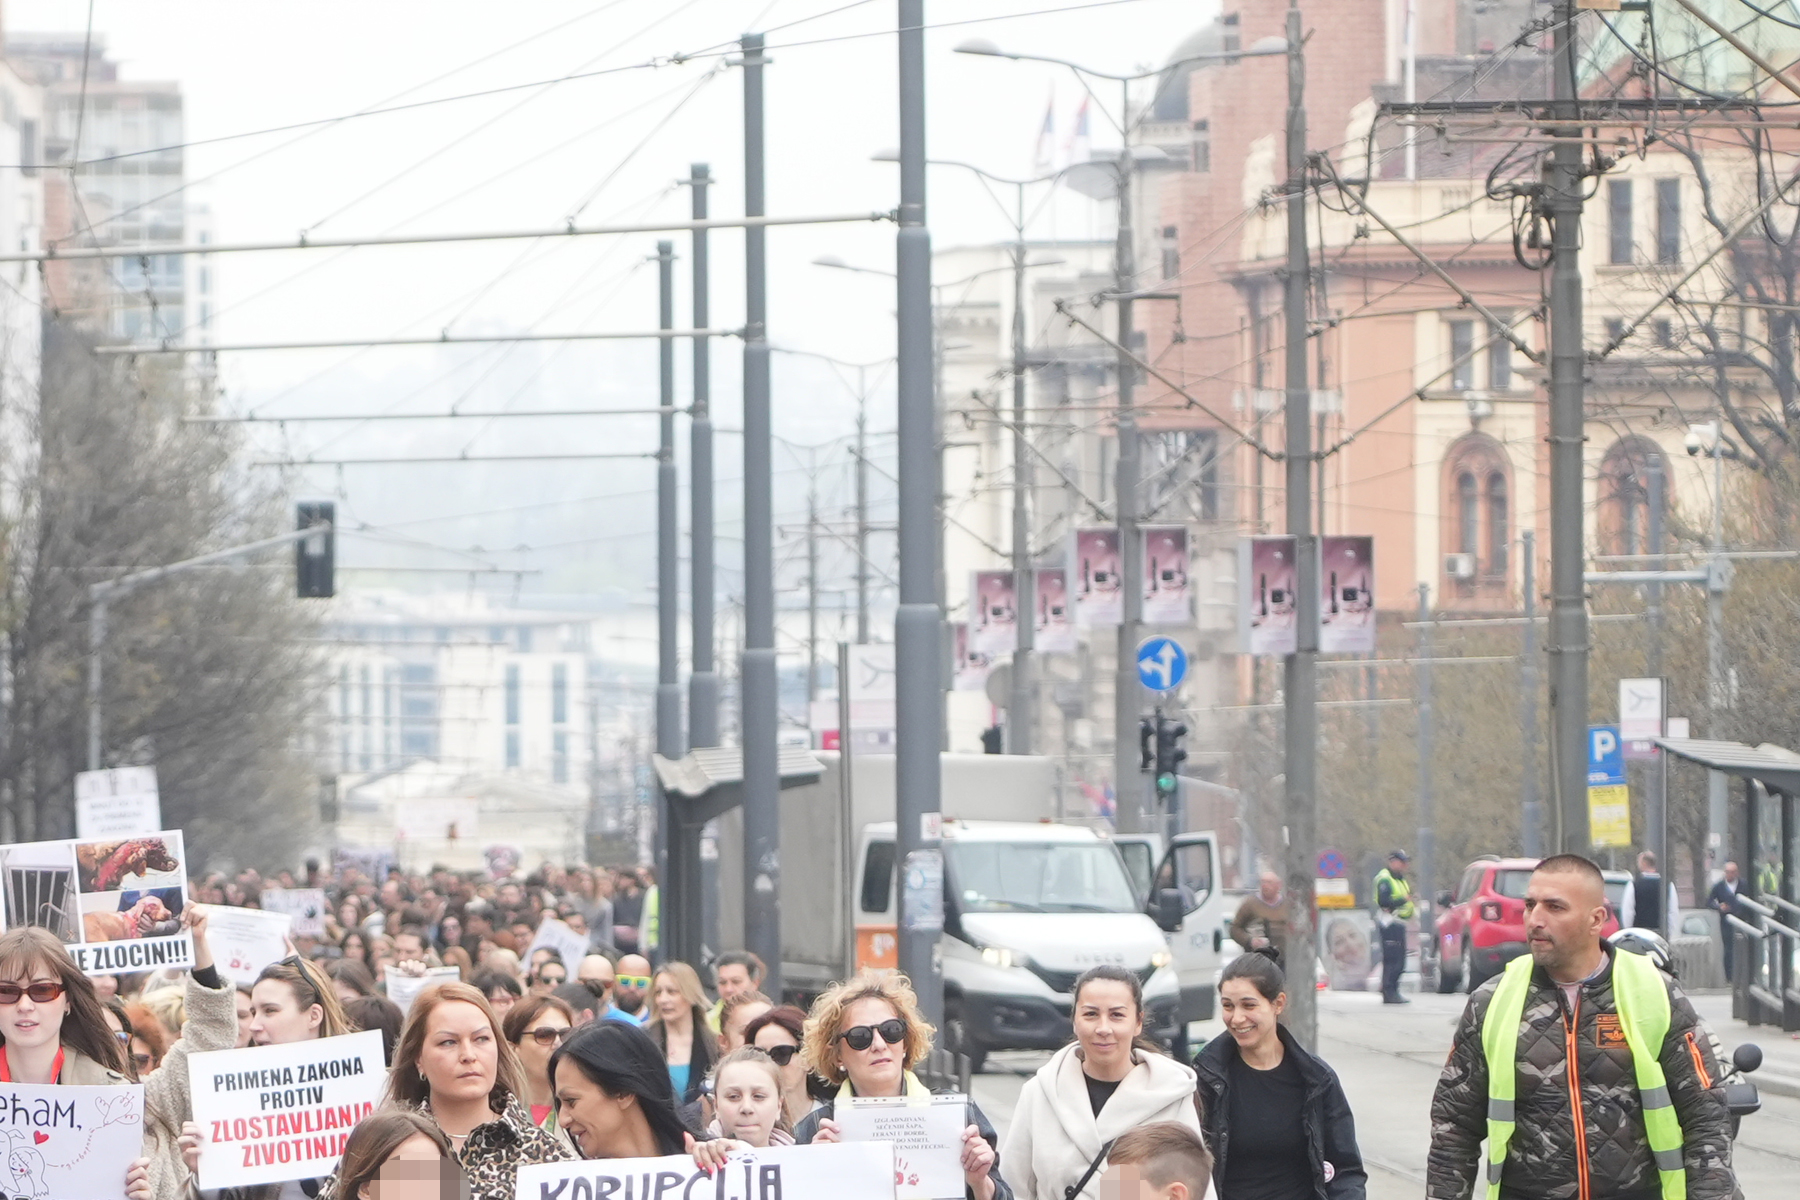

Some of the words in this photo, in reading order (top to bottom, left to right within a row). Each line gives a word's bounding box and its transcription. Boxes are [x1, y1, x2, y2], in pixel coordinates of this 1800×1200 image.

[1592, 729, 1617, 763] P
[93, 939, 188, 970] ZLOCIN!!!
[213, 1067, 294, 1092] PRIMENA
[297, 1056, 364, 1083] ZAKONA
[260, 1085, 323, 1110] PROTIV
